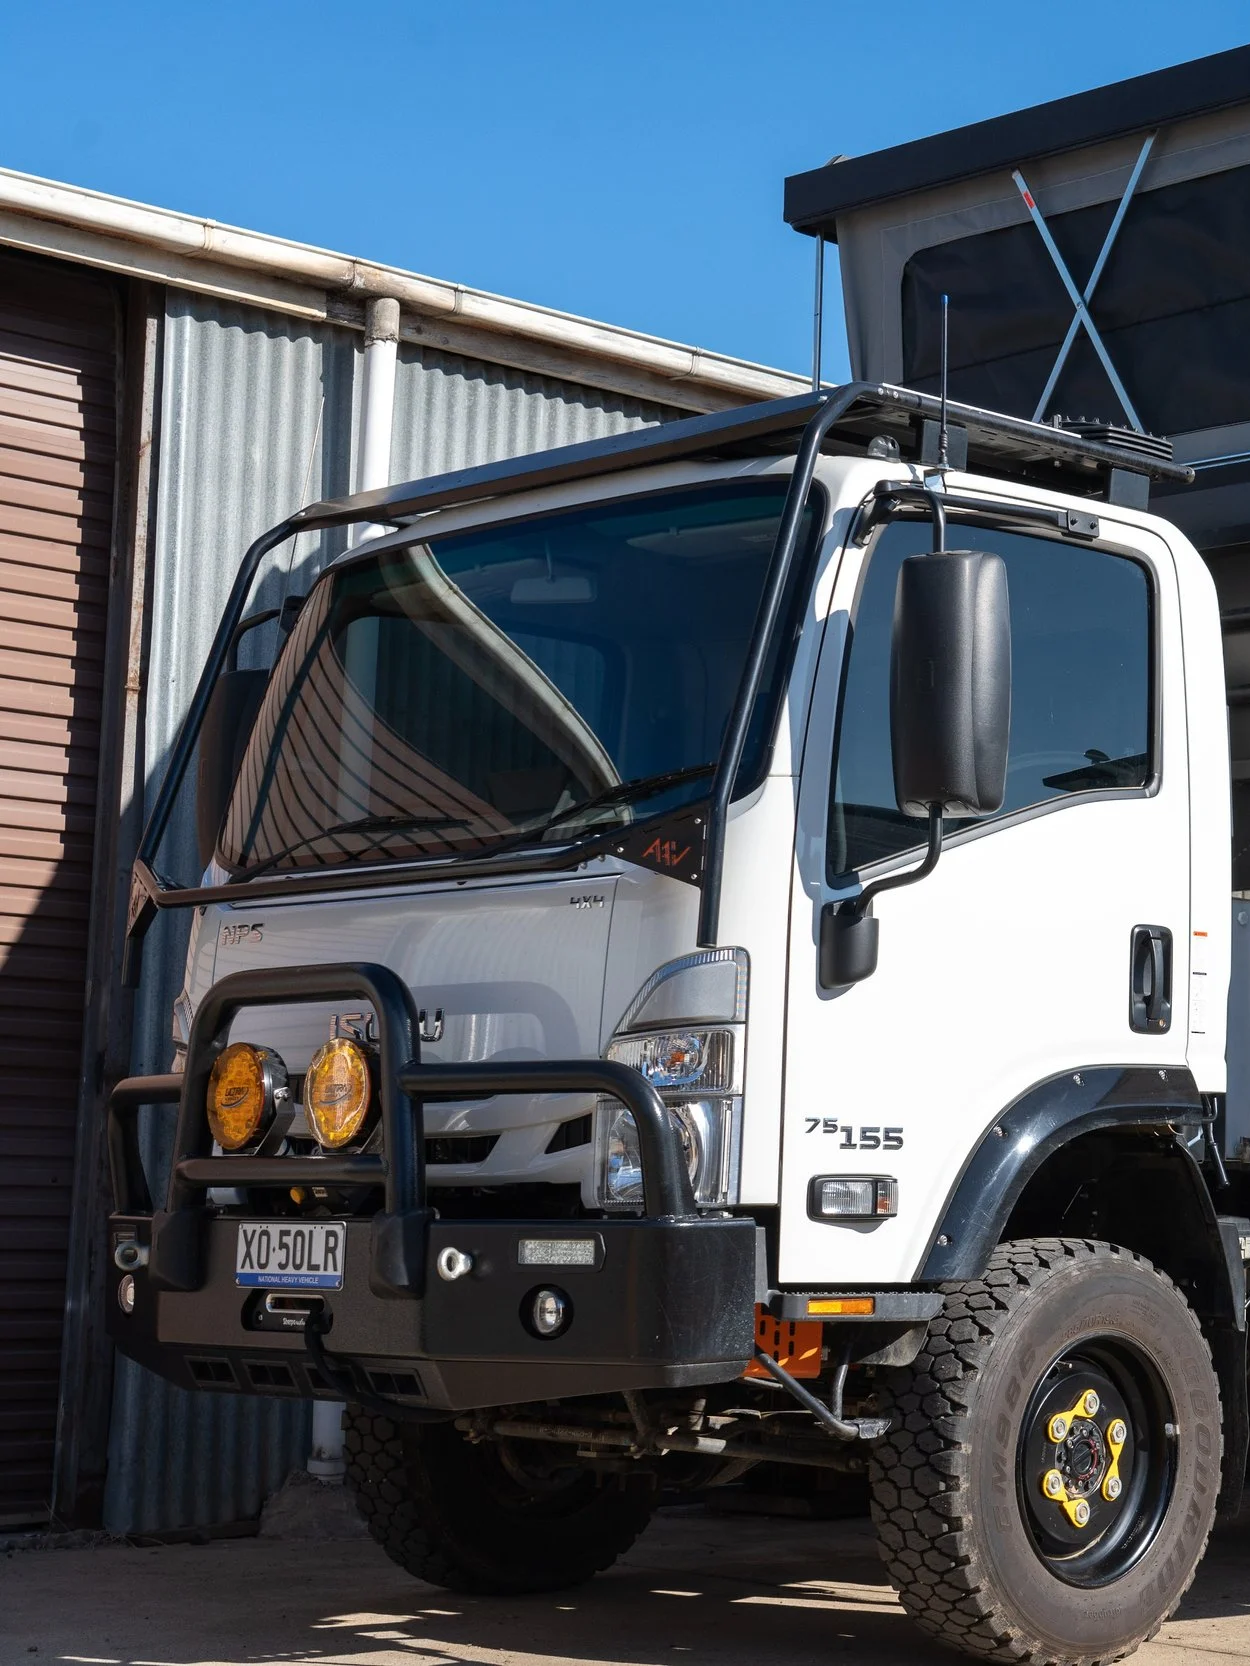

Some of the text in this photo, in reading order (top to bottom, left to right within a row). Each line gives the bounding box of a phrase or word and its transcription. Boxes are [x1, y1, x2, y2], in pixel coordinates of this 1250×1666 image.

[222, 923, 265, 945] NPS
[329, 1008, 445, 1042] ISUU
[804, 1117, 904, 1150] 75 155
[257, 1275, 319, 1285] NATIONAL HEAVY VEHICLE
